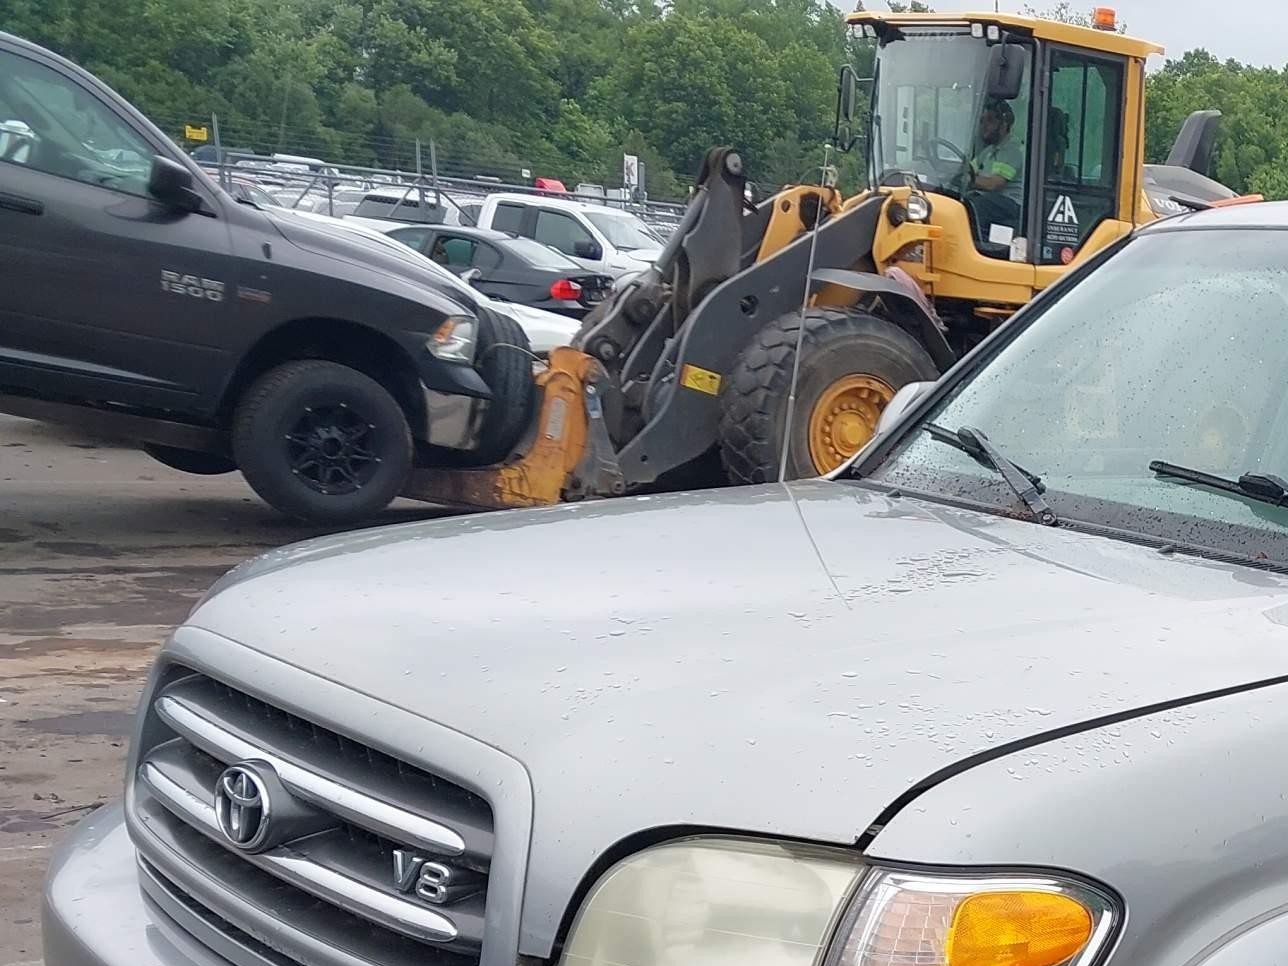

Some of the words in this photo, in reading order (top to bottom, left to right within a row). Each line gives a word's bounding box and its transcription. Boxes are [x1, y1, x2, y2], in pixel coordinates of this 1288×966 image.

[1047, 194, 1079, 224] IAA
[160, 280, 224, 302] 1500
[393, 850, 453, 904] V8
